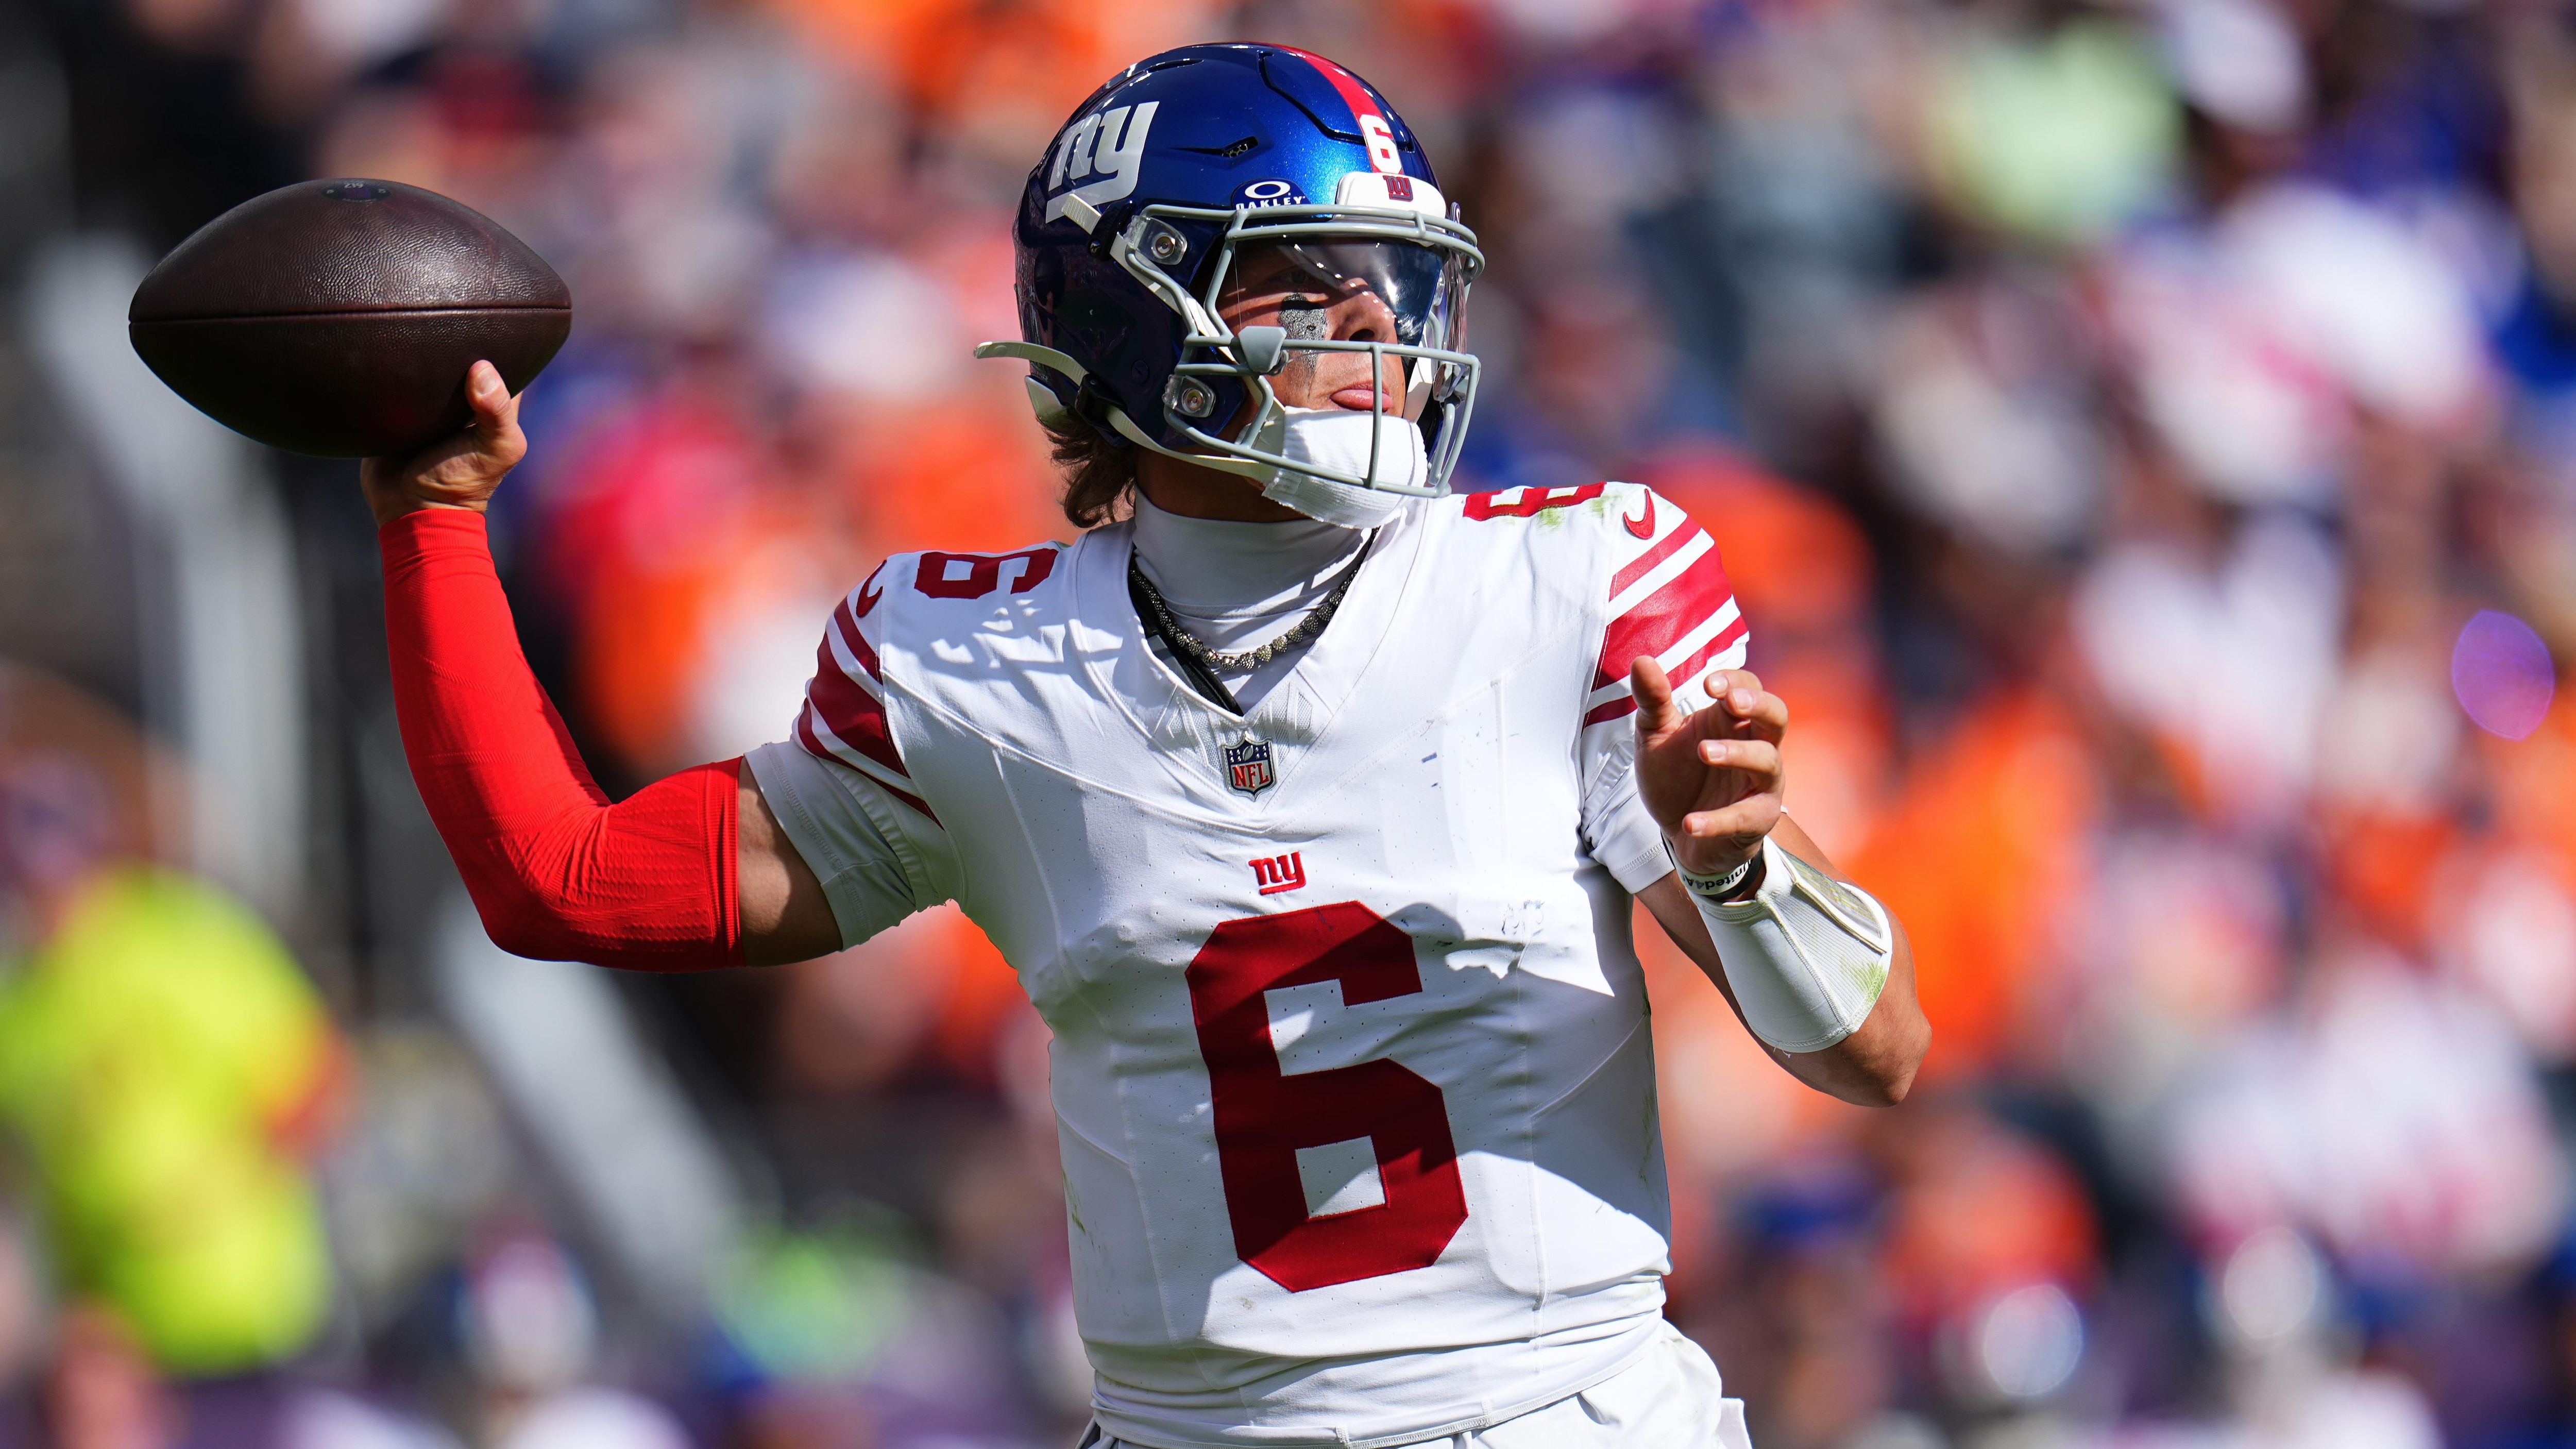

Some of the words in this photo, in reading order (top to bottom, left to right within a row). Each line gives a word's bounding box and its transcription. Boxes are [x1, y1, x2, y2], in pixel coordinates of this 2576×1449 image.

[1359, 114, 1403, 174] 6
[1235, 196, 1302, 210] OAKLEY
[914, 548, 1059, 599] 6
[1231, 762, 1270, 789] NFL
[1185, 900, 1468, 1292] 6
